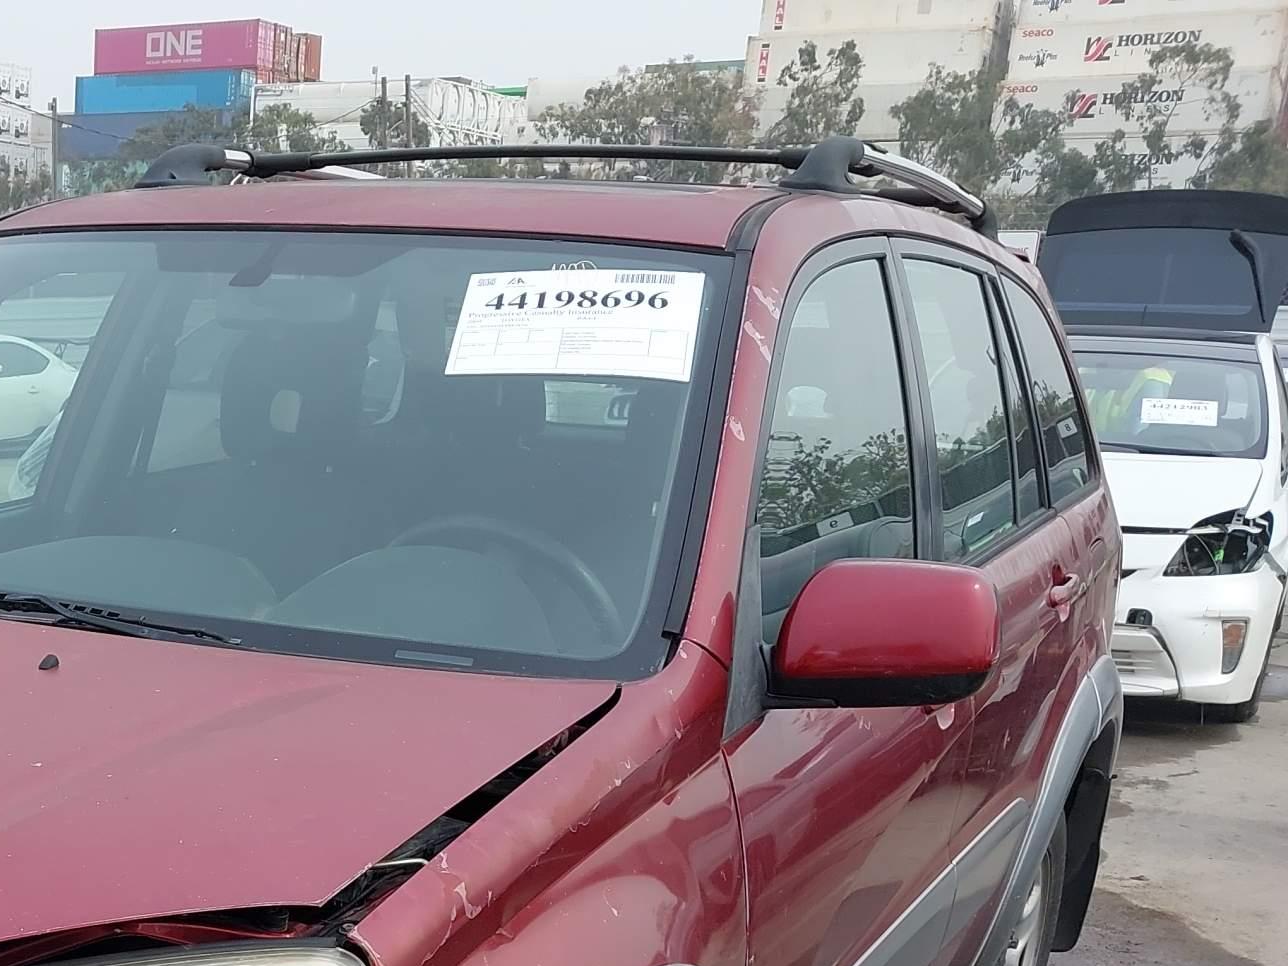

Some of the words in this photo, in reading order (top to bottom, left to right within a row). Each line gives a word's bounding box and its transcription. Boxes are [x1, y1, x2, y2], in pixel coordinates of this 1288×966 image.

[1022, 28, 1054, 38] seaco
[1116, 30, 1202, 47] HORIZON
[146, 30, 202, 57] ONE
[1007, 84, 1038, 94] seaco
[484, 290, 670, 310] 44198696
